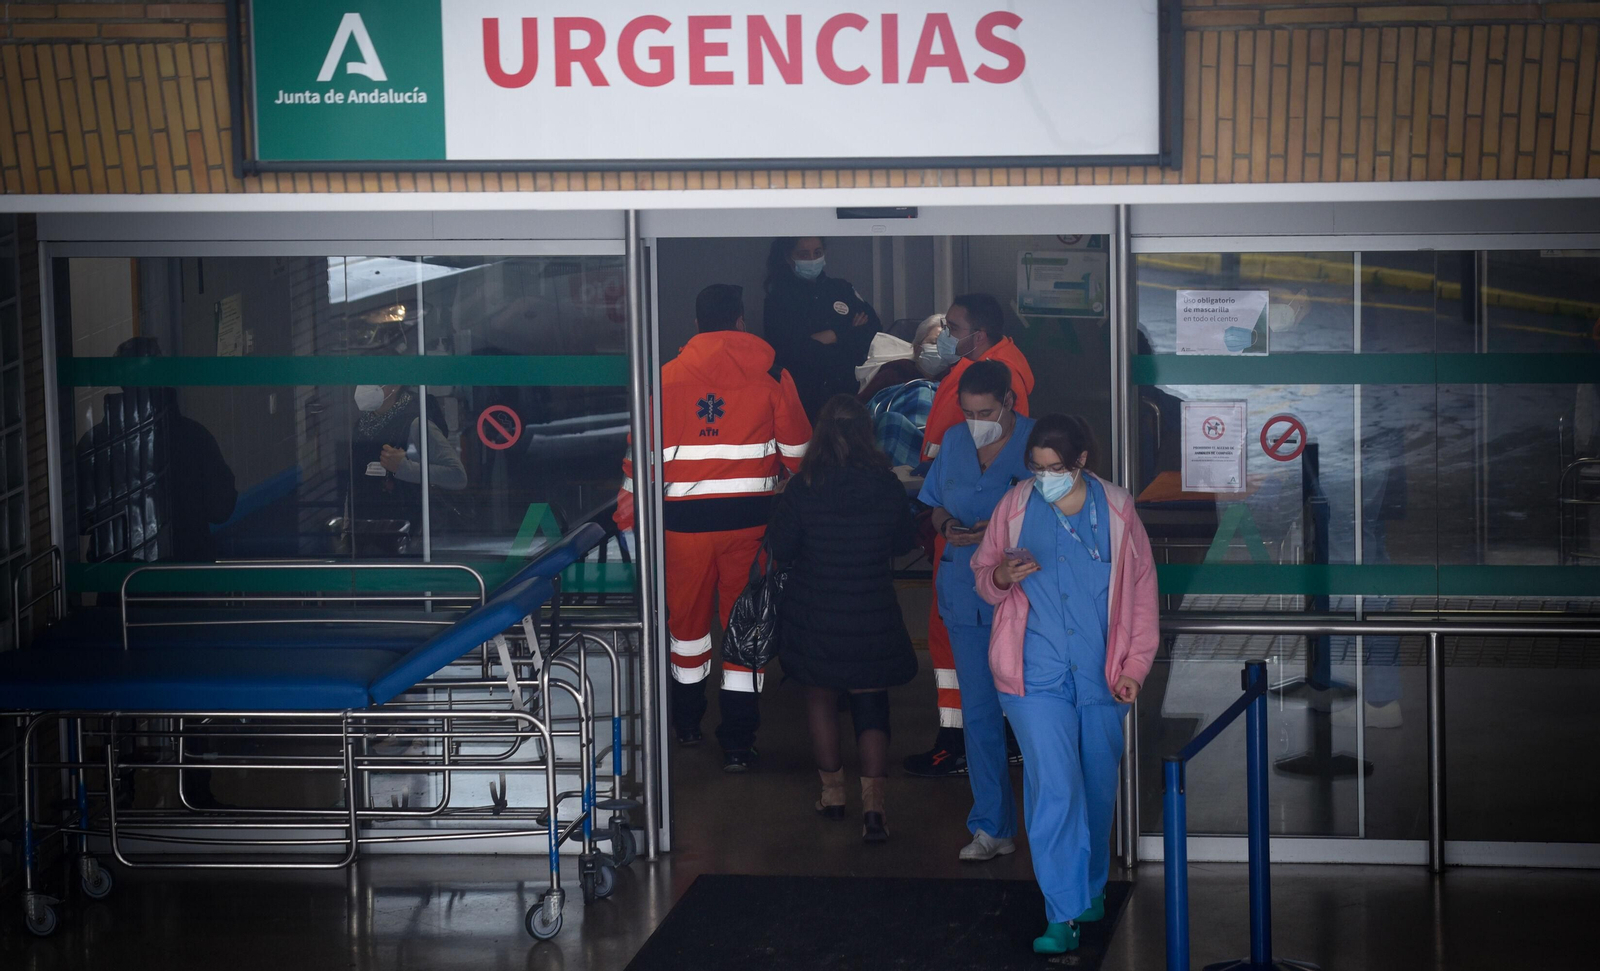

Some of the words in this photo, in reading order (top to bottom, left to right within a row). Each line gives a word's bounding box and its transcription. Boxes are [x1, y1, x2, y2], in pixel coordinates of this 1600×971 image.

[482, 11, 1026, 89] URGENCIAS
[274, 90, 321, 104] Junta
[324, 89, 345, 104] de
[347, 87, 428, 104] Andalucía
[1197, 296, 1236, 305] obligatorio
[699, 428, 719, 437] ATH
